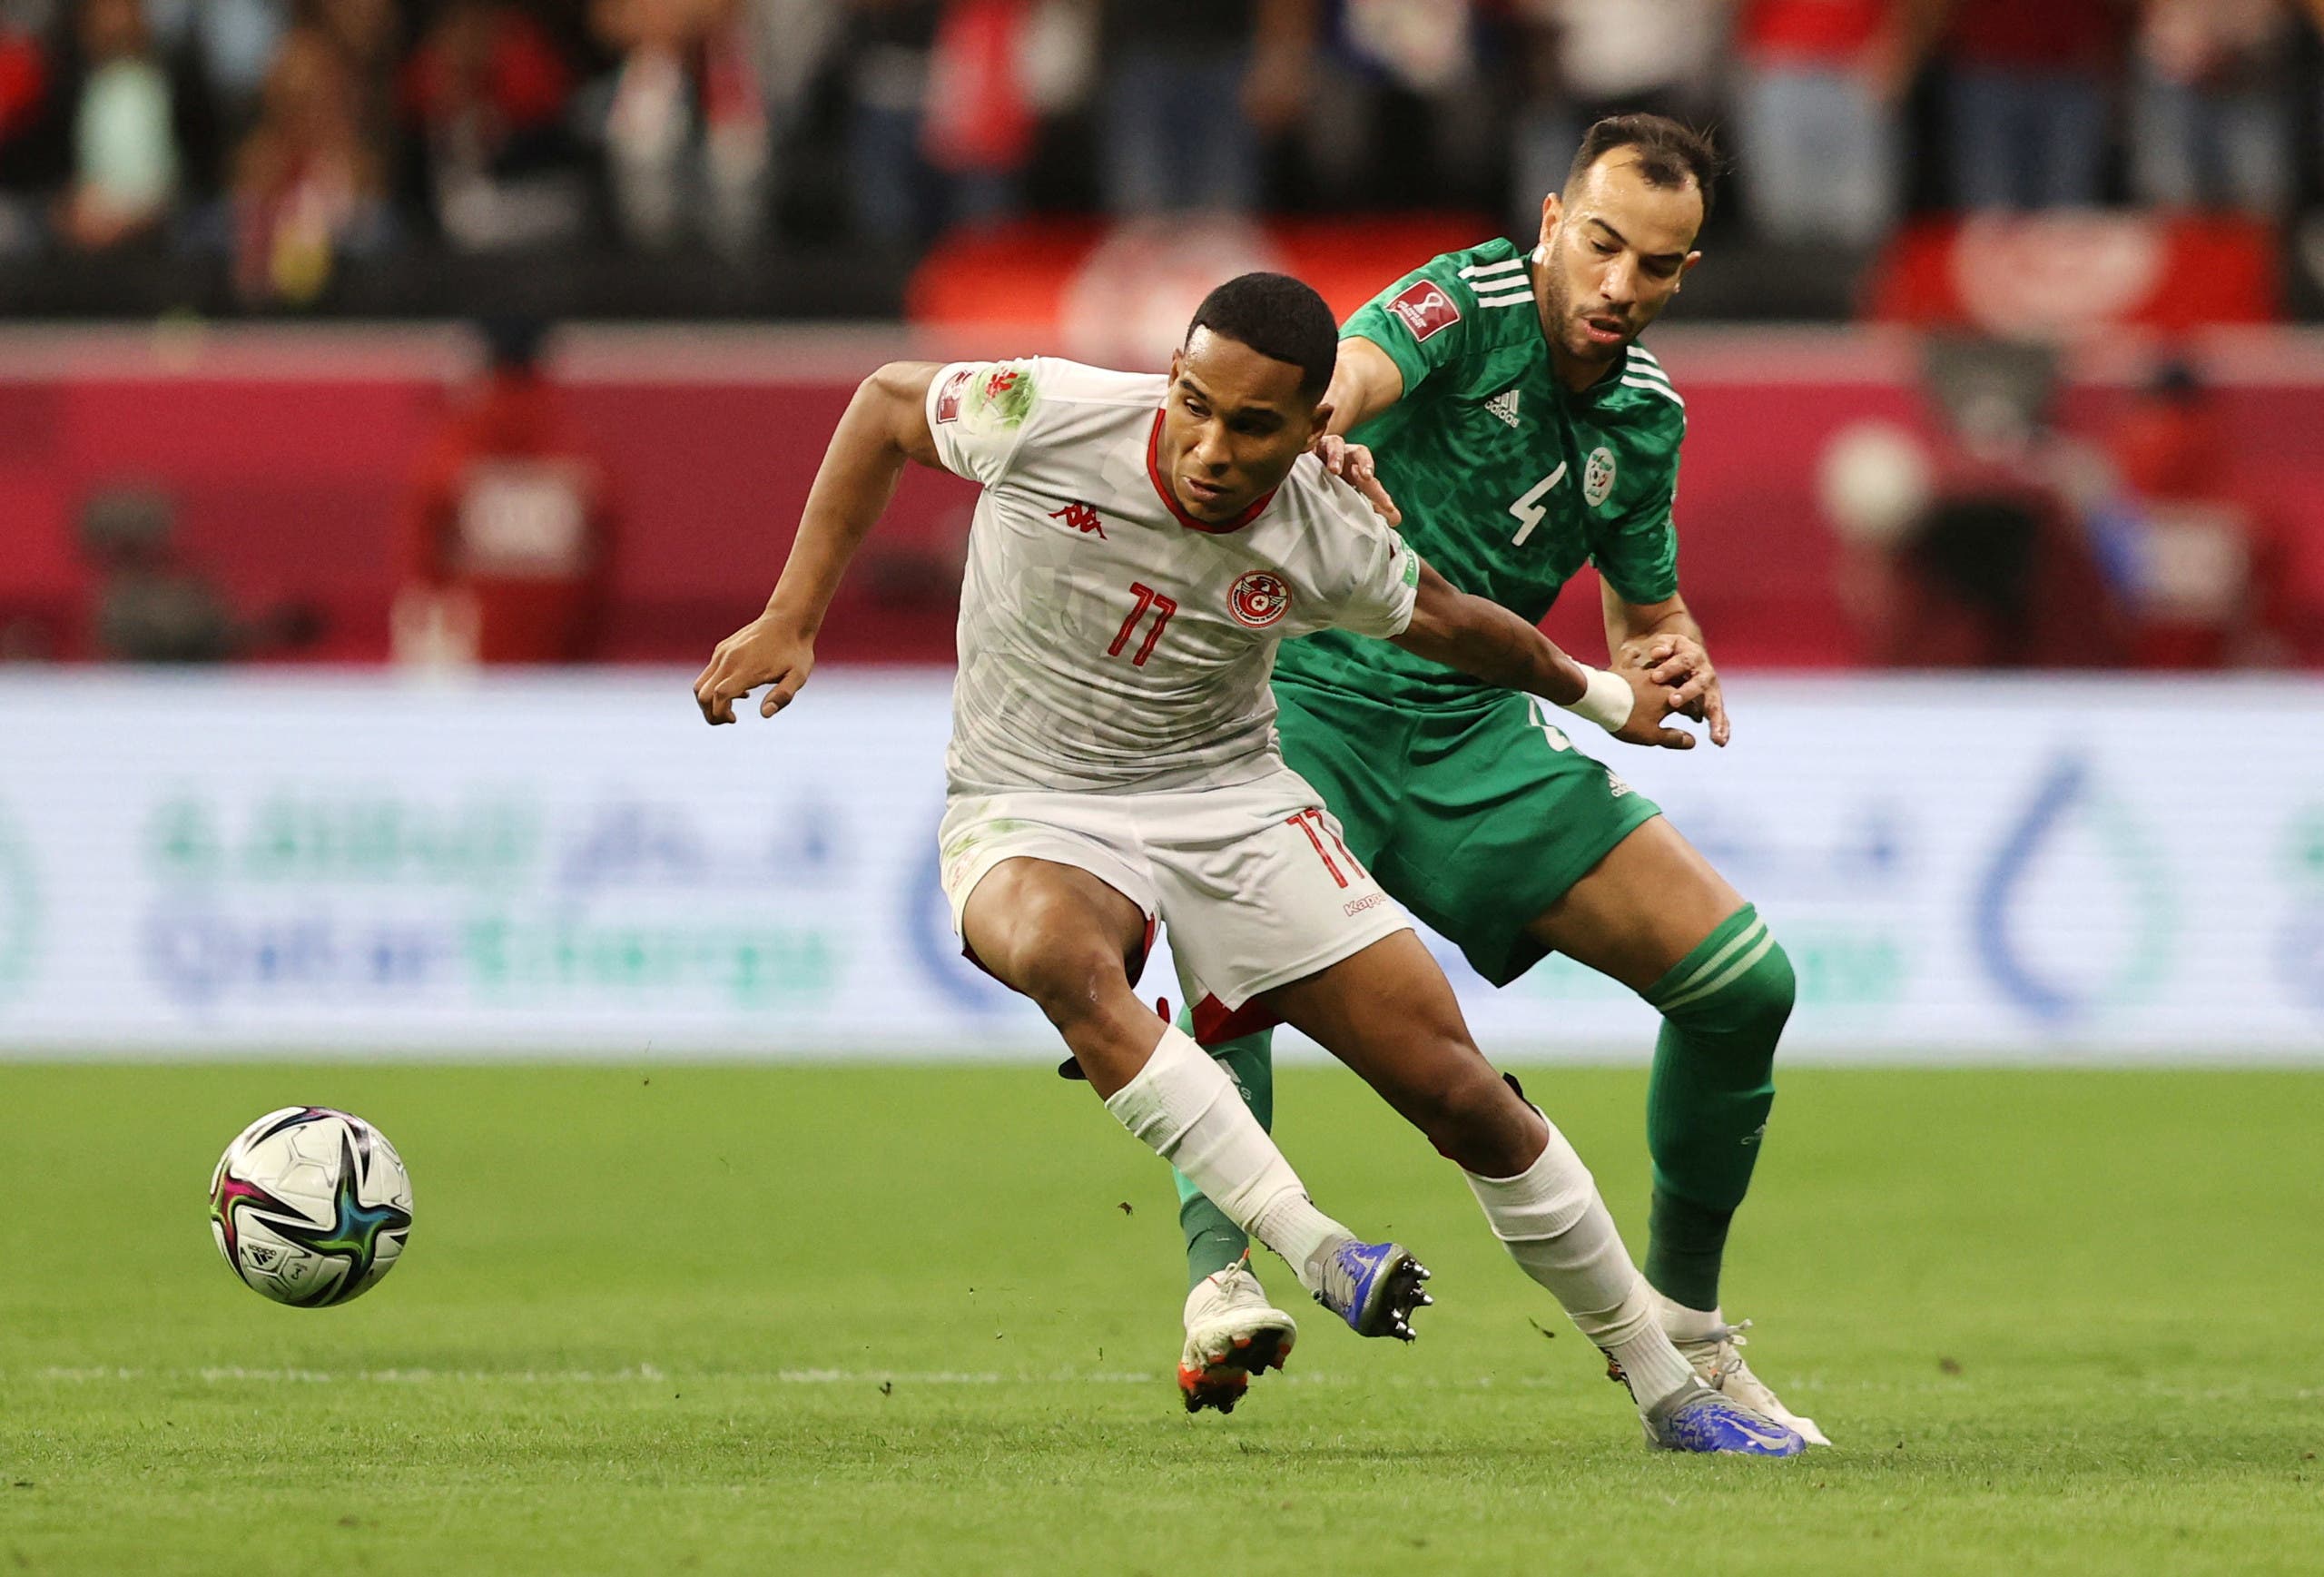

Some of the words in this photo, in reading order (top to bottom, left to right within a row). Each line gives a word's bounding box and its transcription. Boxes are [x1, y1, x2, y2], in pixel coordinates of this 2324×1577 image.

[1484, 400, 1520, 428] adidas
[1509, 461, 1567, 547] 4
[1344, 892, 1386, 917] Kapp
